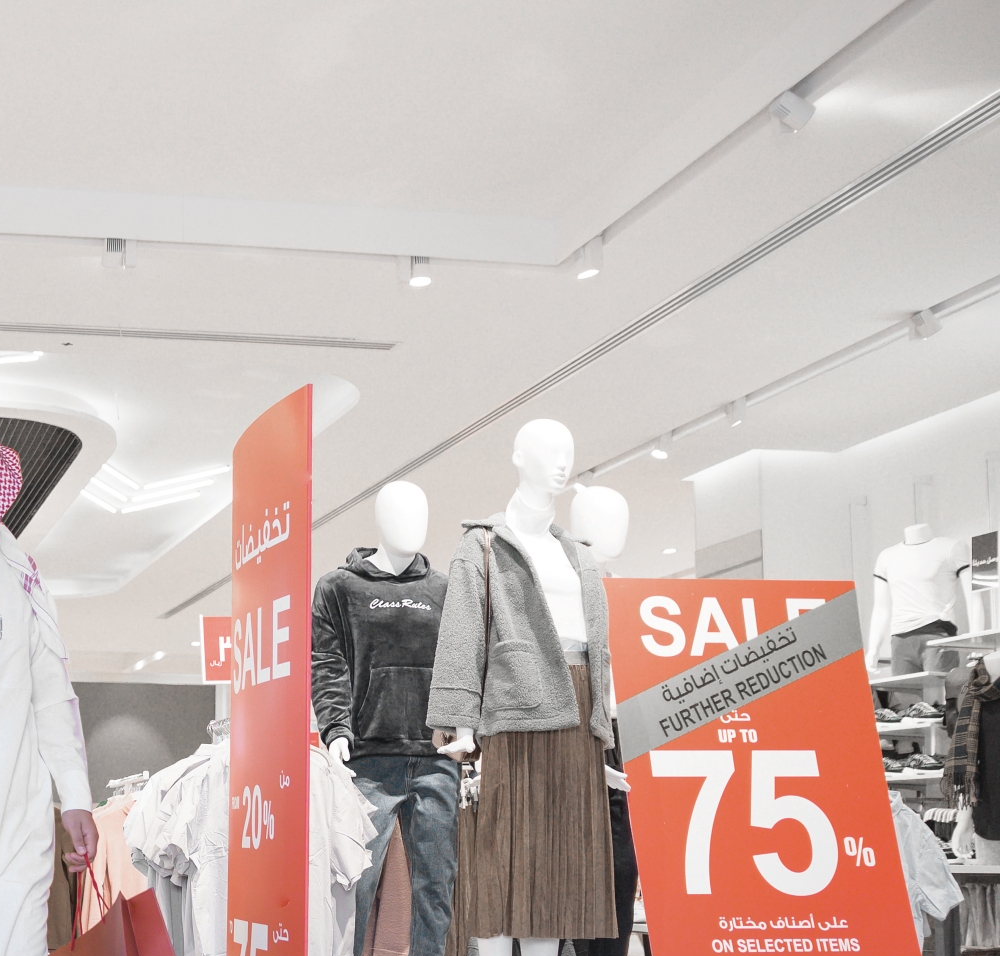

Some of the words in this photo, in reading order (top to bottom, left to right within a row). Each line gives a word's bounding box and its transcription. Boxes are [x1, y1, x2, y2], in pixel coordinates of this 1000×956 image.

[234, 500, 291, 571] تخفيضات
[233, 594, 291, 695] SALE
[720, 626, 798, 675] تخفيضات
[658, 688, 738, 738] FURTHER
[735, 643, 828, 701] REDUCTION
[661, 664, 723, 705] إضافية
[719, 708, 751, 724] حتى
[717, 728, 737, 743] UP
[739, 728, 758, 743] TO
[278, 769, 291, 789] من
[241, 784, 275, 850] 20%
[648, 749, 877, 897] 75%
[718, 916, 767, 932] مختارة
[769, 913, 815, 929] أصناف
[817, 916, 849, 931] على
[272, 922, 289, 944] حتى
[711, 939, 734, 953] ON
[737, 938, 813, 953] SELECTED
[816, 938, 861, 952] ITEMS
